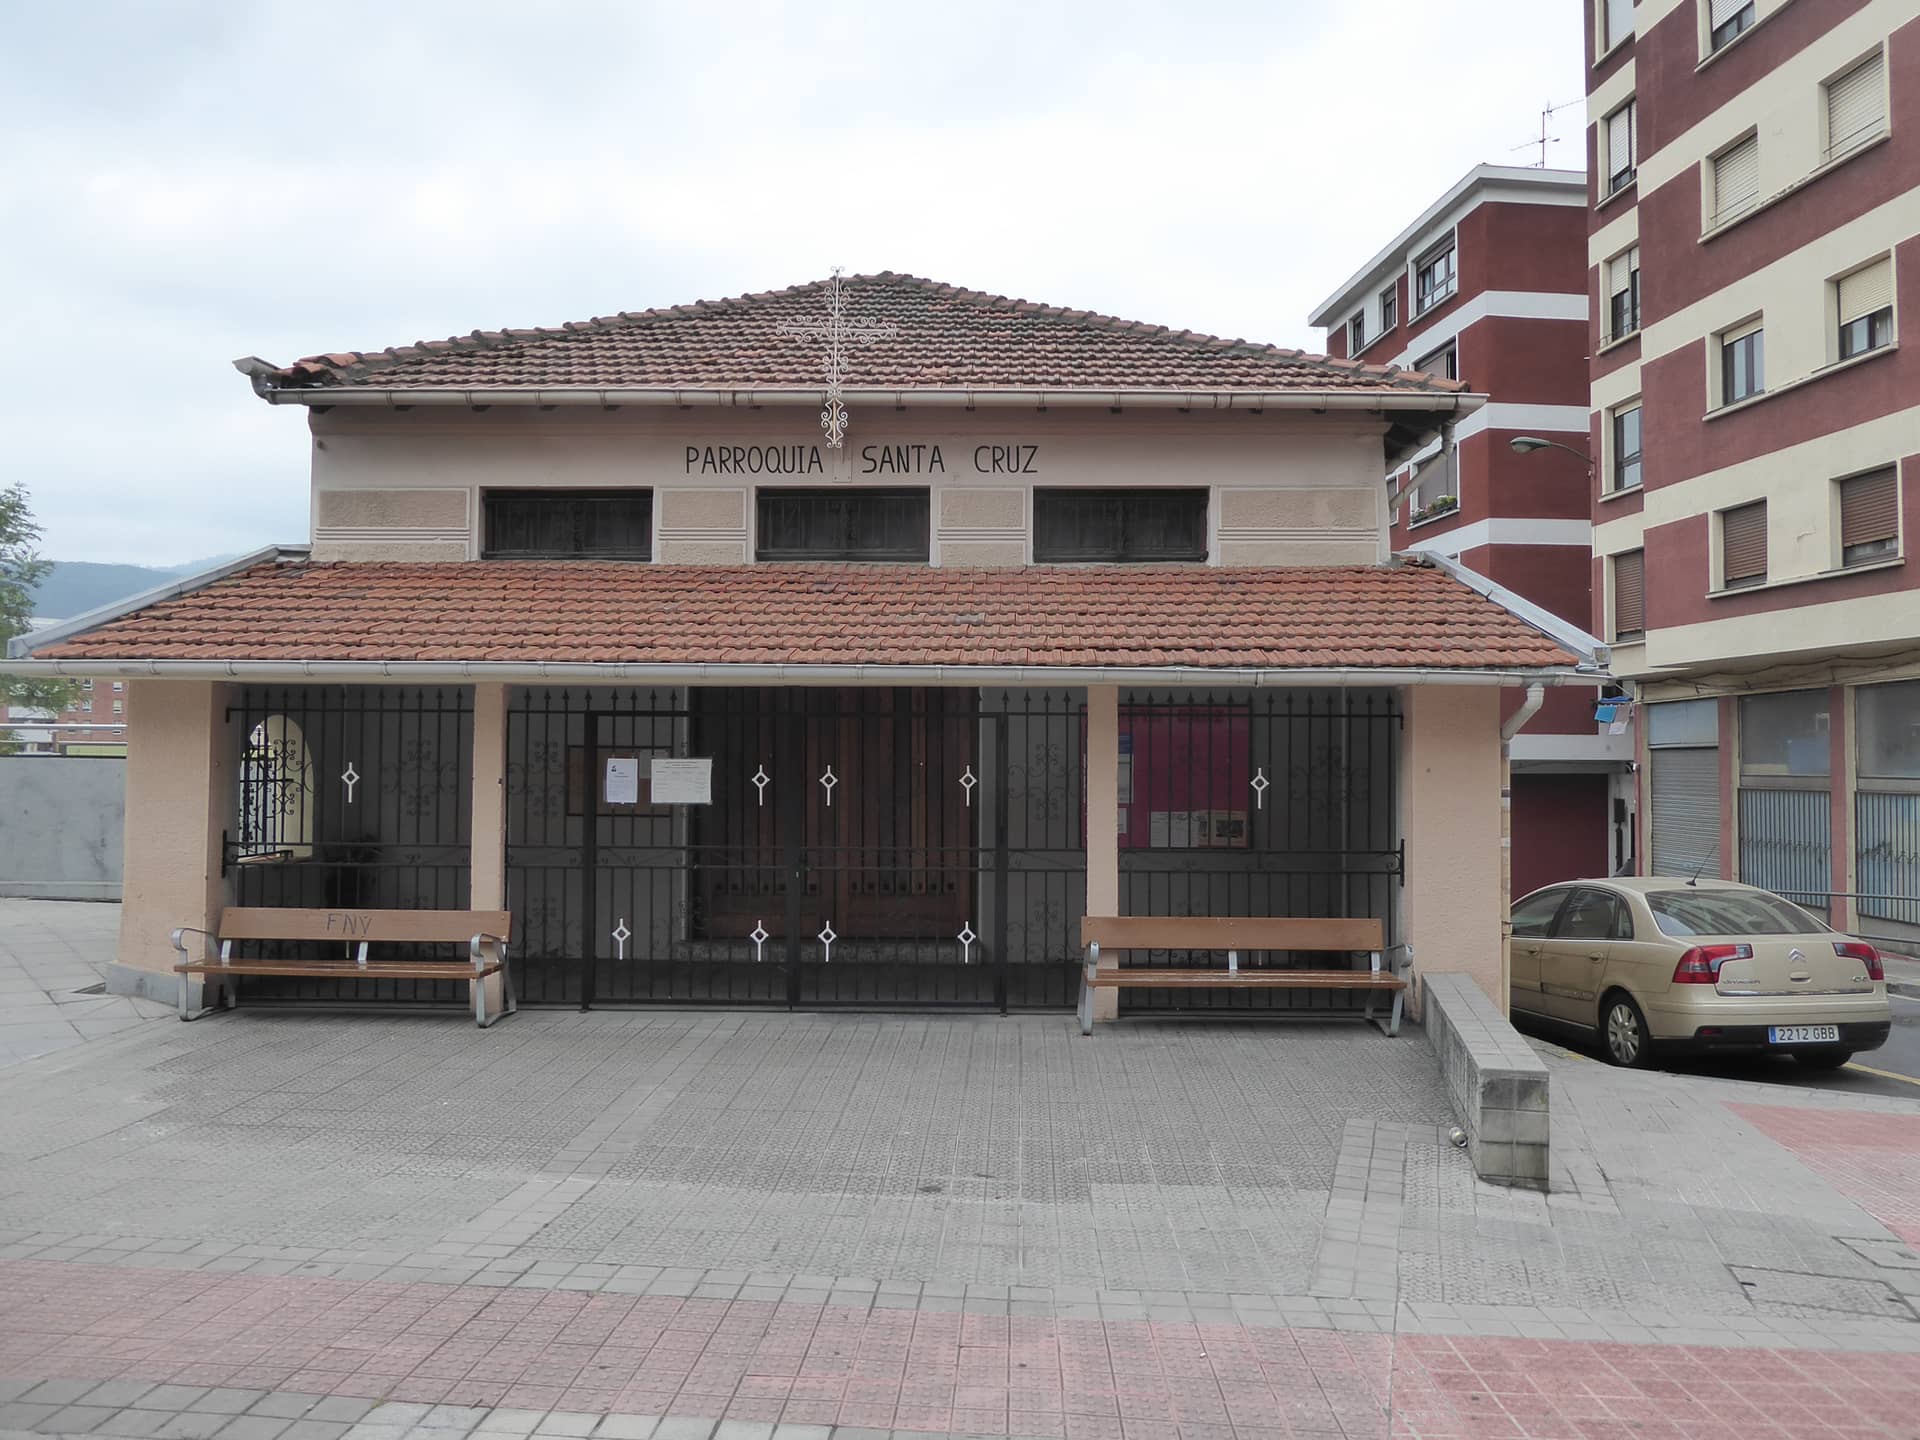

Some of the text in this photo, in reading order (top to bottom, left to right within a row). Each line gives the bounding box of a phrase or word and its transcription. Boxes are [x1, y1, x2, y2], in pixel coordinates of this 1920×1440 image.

[685, 446, 1039, 474] PARROQUIA SANTA CRUZ
[1778, 1027, 1836, 1041] 2212 GBB
